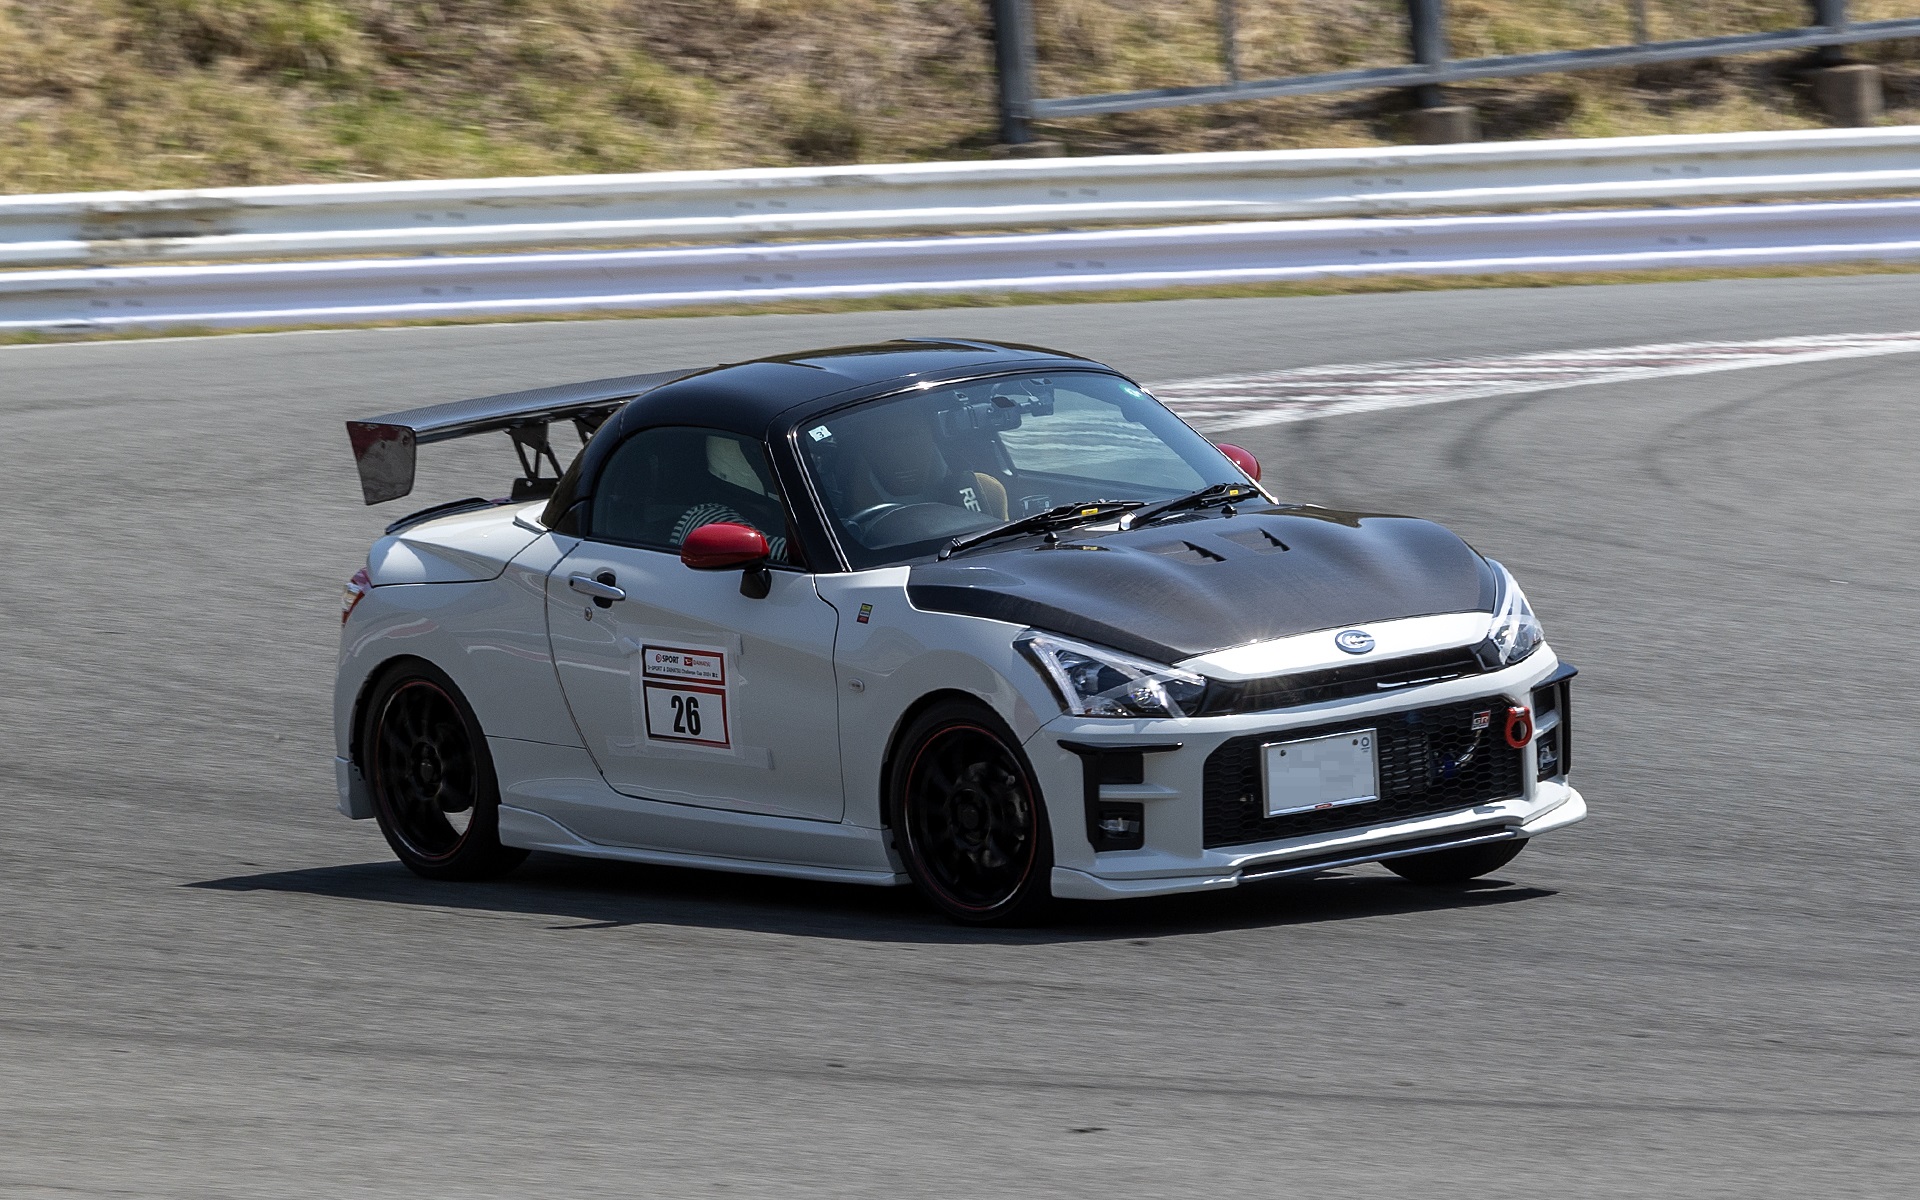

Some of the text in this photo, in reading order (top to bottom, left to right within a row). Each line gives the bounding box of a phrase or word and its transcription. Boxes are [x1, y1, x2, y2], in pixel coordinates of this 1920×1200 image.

[816, 431, 825, 439] 3
[662, 654, 679, 664] SPORT
[671, 695, 701, 736] 26
[1473, 716, 1489, 725] GR
